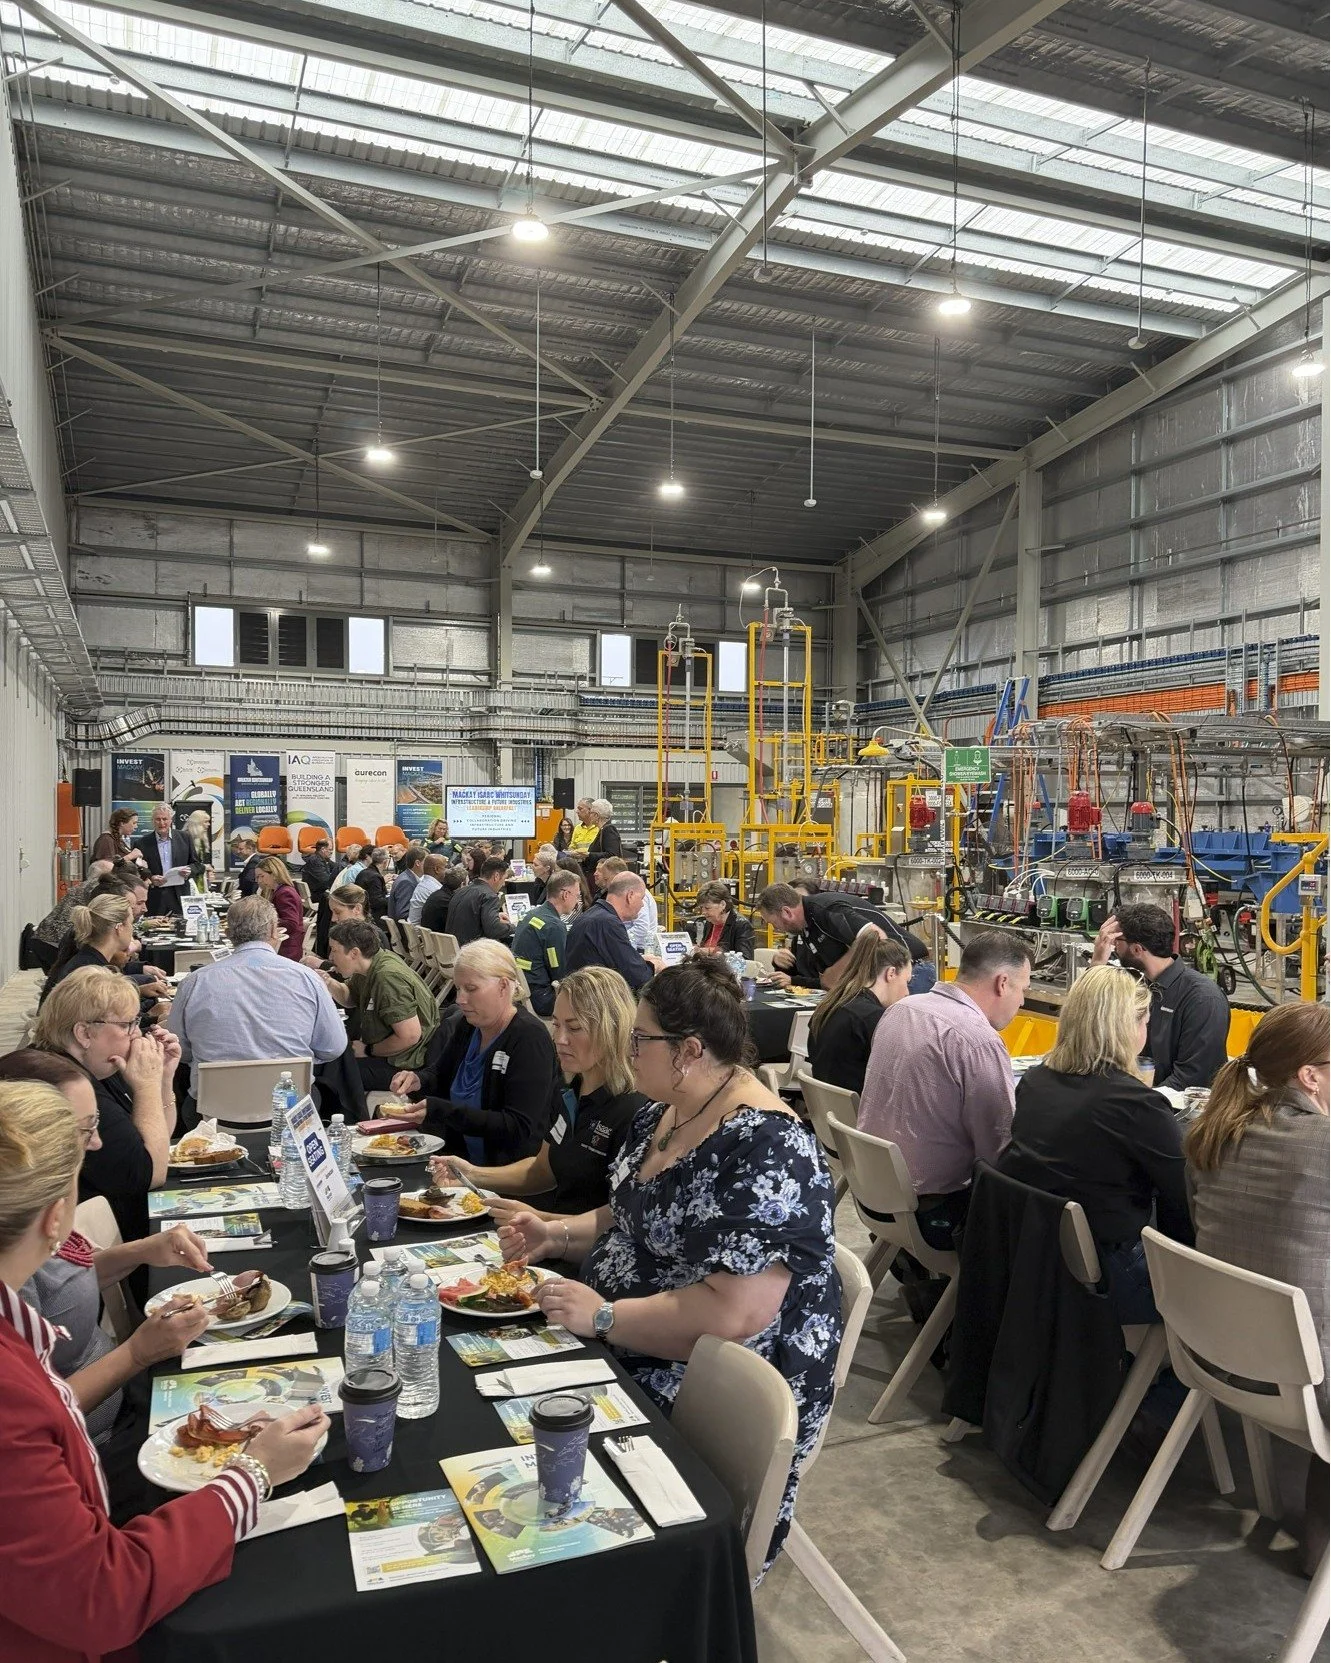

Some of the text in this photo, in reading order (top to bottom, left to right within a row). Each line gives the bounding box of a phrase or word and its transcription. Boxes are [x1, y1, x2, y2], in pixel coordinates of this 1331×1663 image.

[288, 754, 311, 765] IAQ
[251, 791, 277, 799] GLOBALLY
[452, 791, 476, 799] MACKAY
[495, 791, 531, 799] WHITSUNDAY
[235, 799, 245, 807] ACT
[235, 806, 277, 814] DELIVER LOCALLY
[306, 1138, 319, 1155] OPEN
[308, 1145, 325, 1167] SEATING
[391, 1493, 447, 1508] OPPORTUNITY
